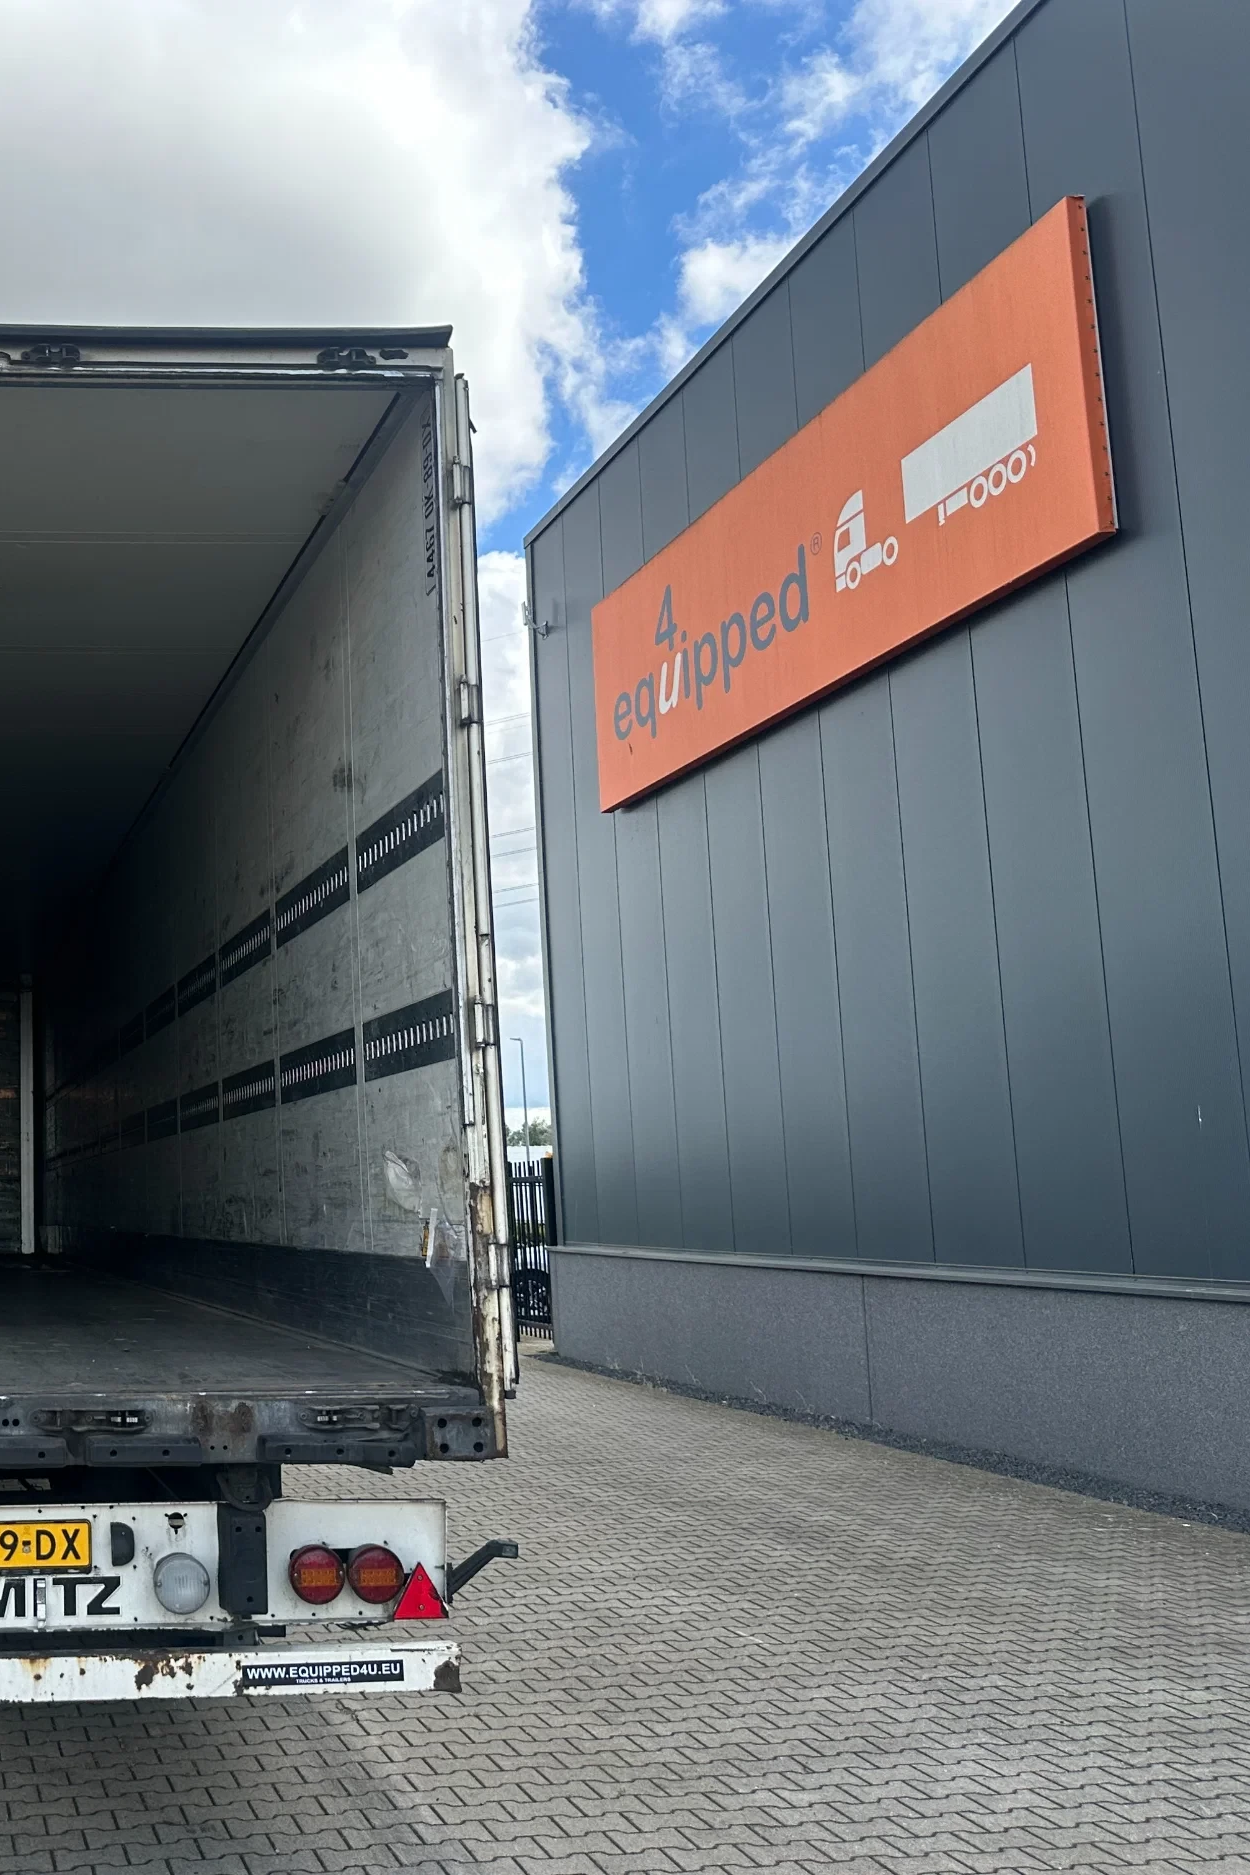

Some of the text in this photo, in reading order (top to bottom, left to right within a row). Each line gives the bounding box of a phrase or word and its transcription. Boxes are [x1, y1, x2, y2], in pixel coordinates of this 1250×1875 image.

[421, 416, 434, 520] OK-89-DX
[614, 543, 810, 740] equipped
[655, 584, 678, 651] 4
[247, 1663, 401, 1680] WWW.EQUIPPED4U.EU
